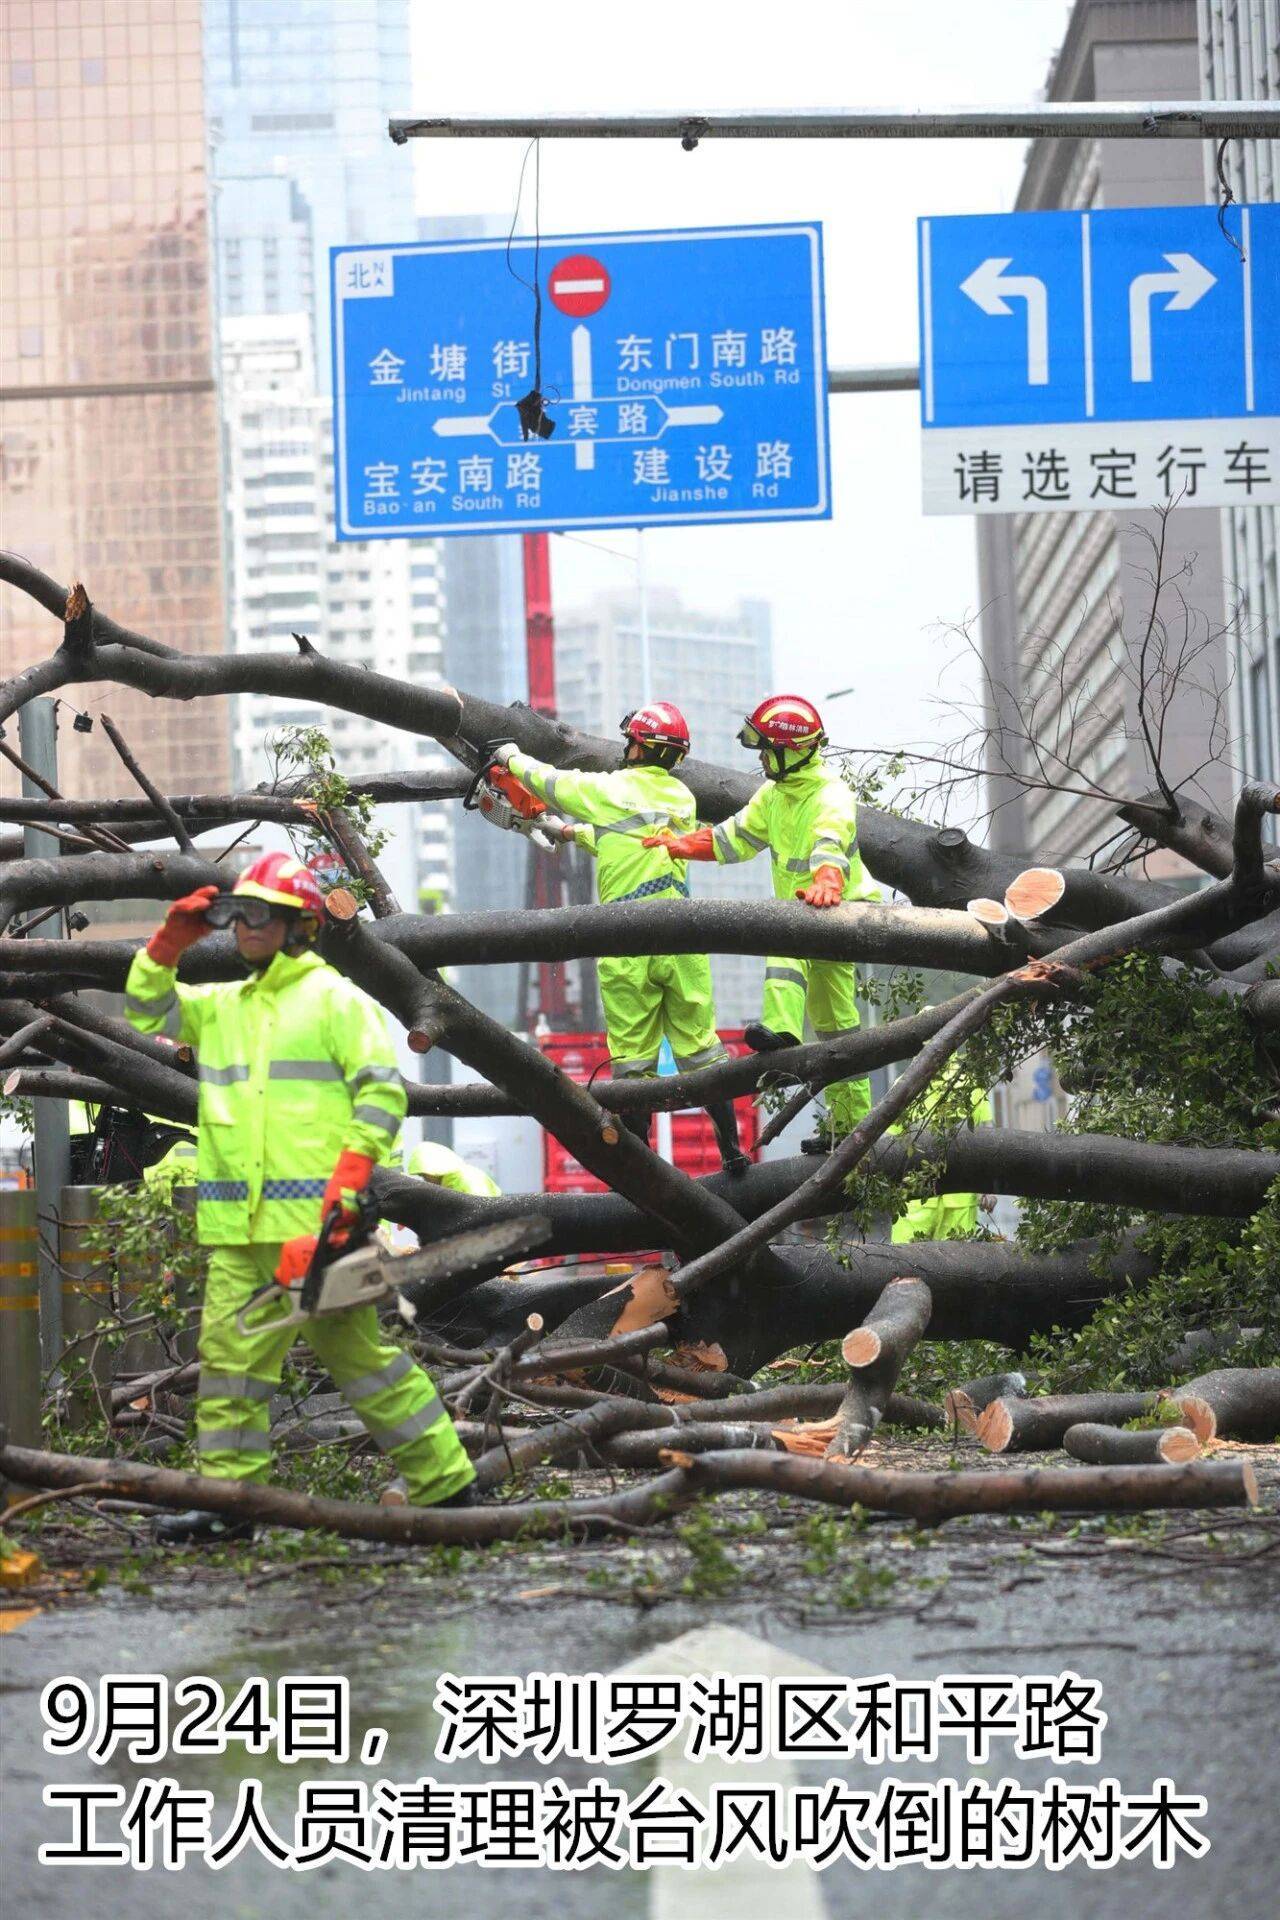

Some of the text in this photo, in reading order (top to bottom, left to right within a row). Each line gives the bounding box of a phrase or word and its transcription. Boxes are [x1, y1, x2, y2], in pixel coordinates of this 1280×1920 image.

[348, 263, 370, 289] 北
[373, 261, 384, 274] N
[368, 340, 531, 386] 金塘街
[616, 326, 798, 372] 东门南路
[396, 382, 511, 404] Jintang St
[617, 369, 800, 394] Dongmen South Rd
[519, 402, 648, 440] 宾路
[363, 451, 543, 499] 宝安南路
[632, 440, 793, 486] 建设路
[954, 441, 1272, 503] 请选定行车
[451, 495, 503, 512] South
[516, 492, 541, 508] Rd
[650, 483, 779, 502] Jianshe Rd
